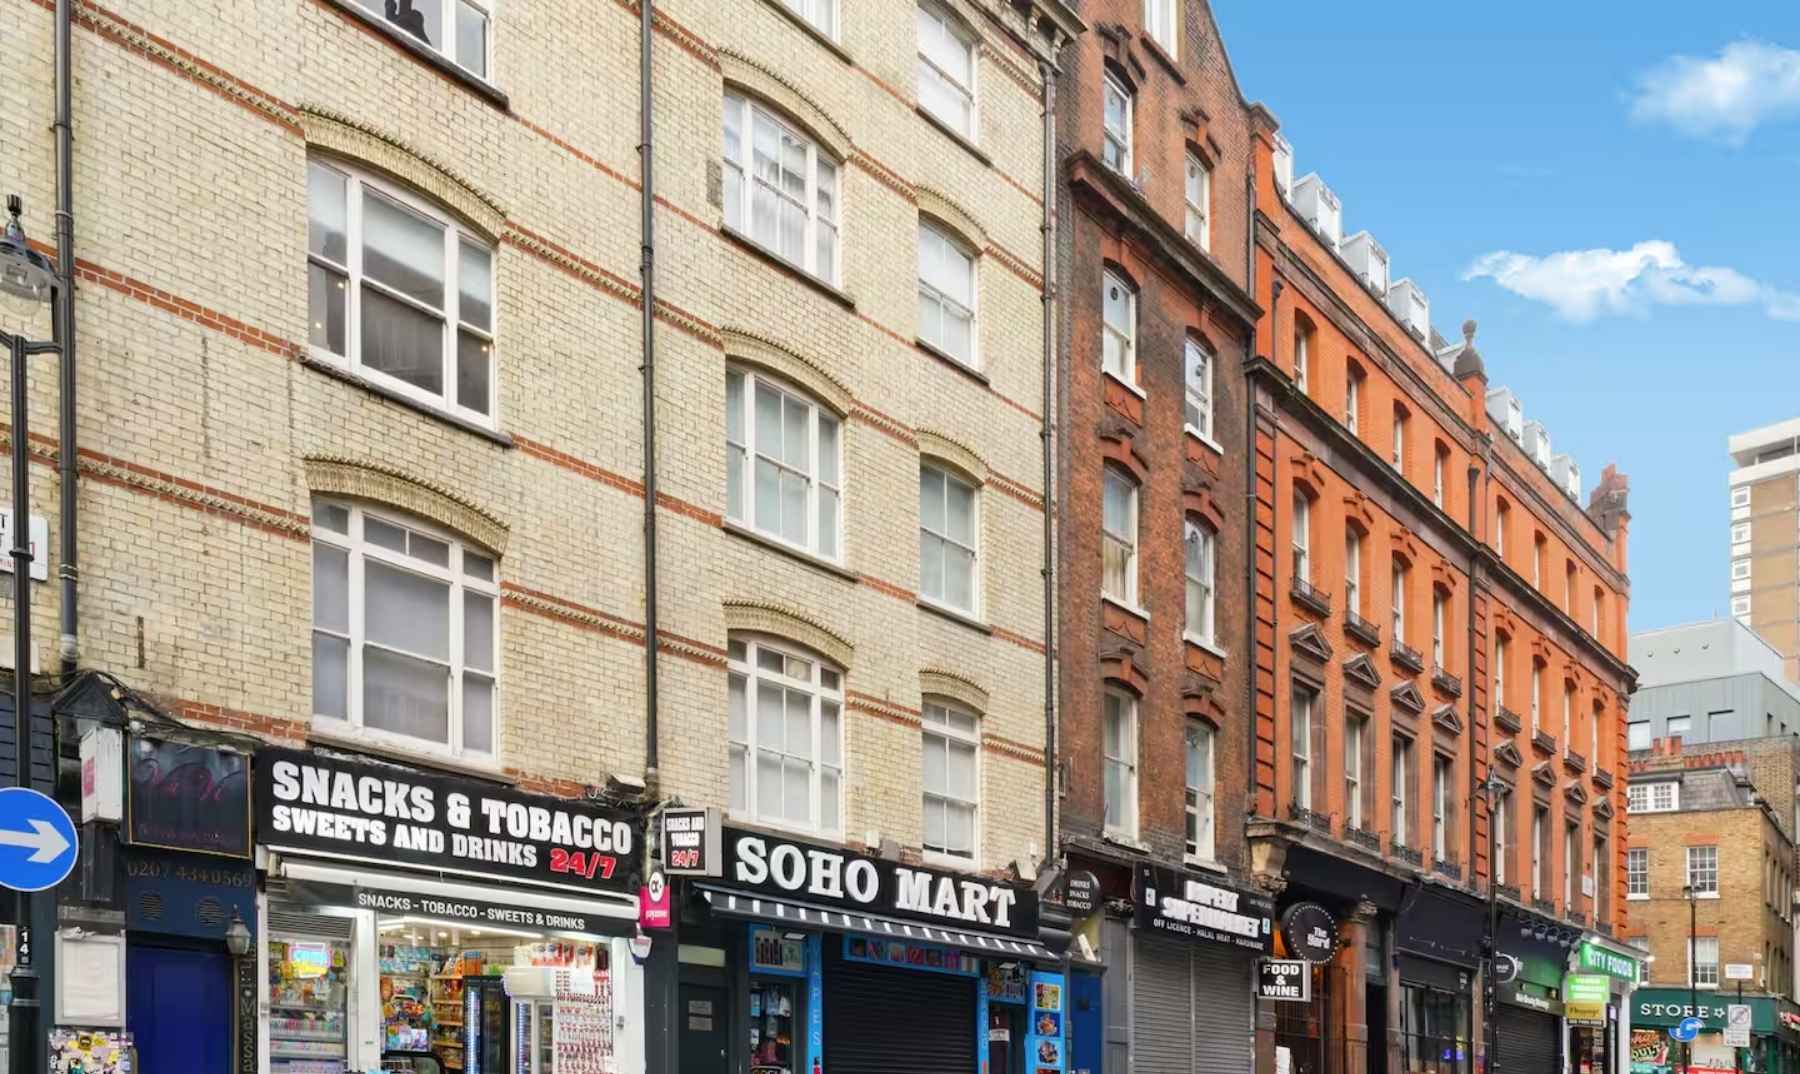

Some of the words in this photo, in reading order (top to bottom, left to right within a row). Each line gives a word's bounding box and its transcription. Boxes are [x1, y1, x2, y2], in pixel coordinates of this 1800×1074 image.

[273, 761, 435, 823] SNACKS
[447, 793, 471, 829] &
[481, 798, 632, 855] TOBACCO
[272, 804, 386, 845] SWEETS
[393, 824, 445, 853] AND
[452, 833, 538, 867] DRINKS
[549, 848, 617, 879] 24/7
[671, 848, 699, 868] 24/7
[736, 836, 879, 904] SOHO
[895, 867, 1016, 928] MART
[358, 893, 411, 911] SNACKS
[421, 900, 477, 918] TOBACCO
[488, 908, 533, 924] SWEETS
[535, 913, 544, 925] &
[546, 914, 585, 930] DRINKS
[1263, 964, 1300, 976] FOOD
[1275, 974, 1286, 985] &
[1262, 985, 1300, 997] WINE
[1640, 1002, 1709, 1018] STORE
